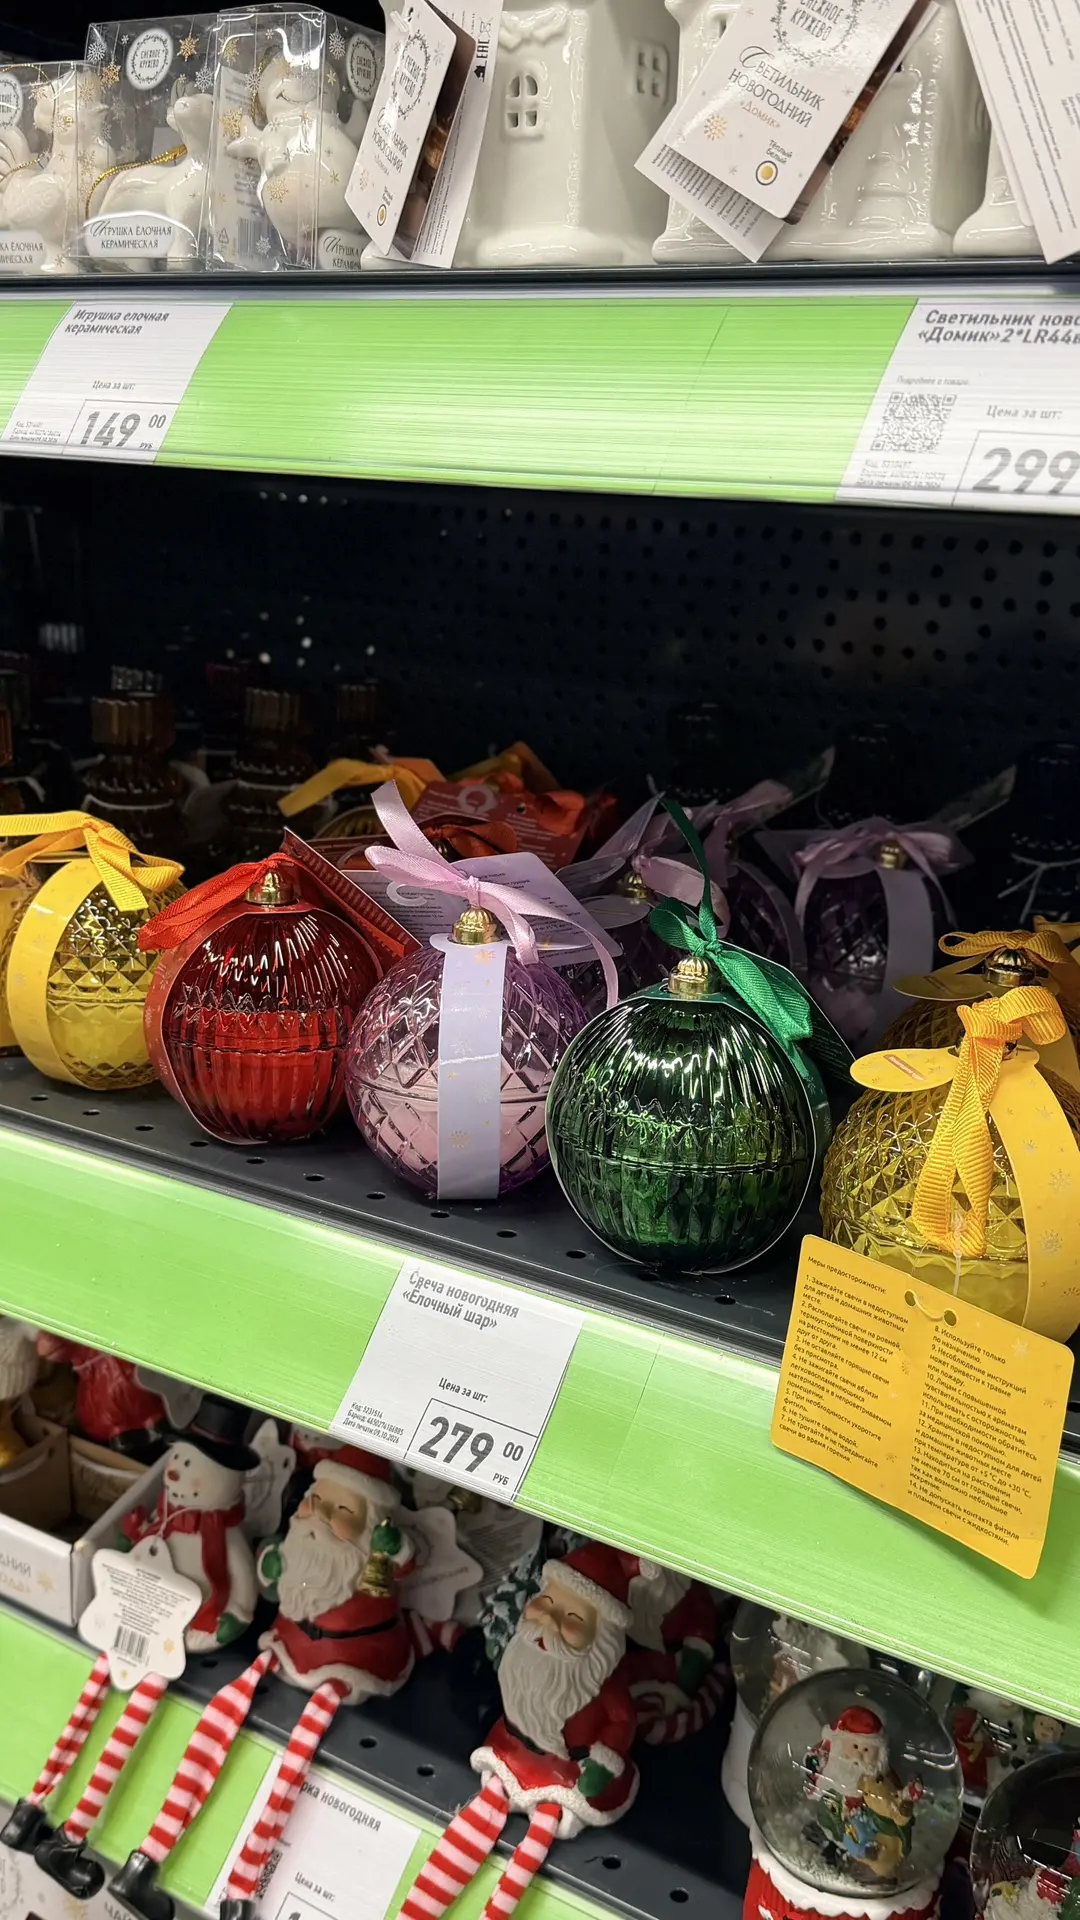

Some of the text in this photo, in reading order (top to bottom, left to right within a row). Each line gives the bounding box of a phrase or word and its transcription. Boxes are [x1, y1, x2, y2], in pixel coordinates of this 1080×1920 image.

[790, 8, 832, 41] КРУЖЕВО
[728, 68, 813, 128] НОВОГОДНИЙ
[73, 309, 170, 323] Игрушка елочная
[925, 309, 1036, 326] Светильник
[64, 323, 142, 335] керамическая
[986, 404, 1021, 420] Цена
[1023, 408, 1040, 419] за
[80, 411, 167, 447] 149 00
[972, 447, 1080, 494] 299
[808, 1256, 825, 1268] Меры
[409, 1270, 520, 1318] Свеча новогодняя
[844, 1292, 862, 1304] свечи
[463, 1310, 498, 1330] шар»
[815, 1289, 834, 1301] детей
[839, 1299, 872, 1318] домашних
[873, 1314, 904, 1332] животных
[848, 1322, 867, 1334] свечи
[982, 1349, 1006, 1364] только
[845, 1359, 871, 1376] горящие
[871, 1372, 889, 1385] свечи
[929, 1354, 949, 1368] может
[949, 1364, 980, 1383] привести
[987, 1382, 1011, 1398] травме
[438, 1377, 489, 1404] Цена за шт:
[839, 1376, 856, 1388] свечи
[856, 1385, 878, 1399] вблизи
[779, 1423, 797, 1435] свечи
[806, 1435, 826, 1448] время
[798, 1413, 821, 1427] тушите
[821, 1424, 838, 1436] свечи
[418, 1416, 525, 1473] 279 00
[927, 1423, 956, 1443] Хранить
[1020, 1469, 1042, 1483] детей
[492, 1472, 510, 1486] РУБ
[934, 1476, 968, 1496] возможно
[913, 1491, 941, 1510] пламени
[942, 1507, 961, 1520] свечи
[963, 1508, 992, 1527] контакта
[993, 1523, 1019, 1540] фитиля
[321, 1791, 382, 1832] новогодняя
[294, 1871, 313, 1889] Цена
[313, 1883, 322, 1894] за
